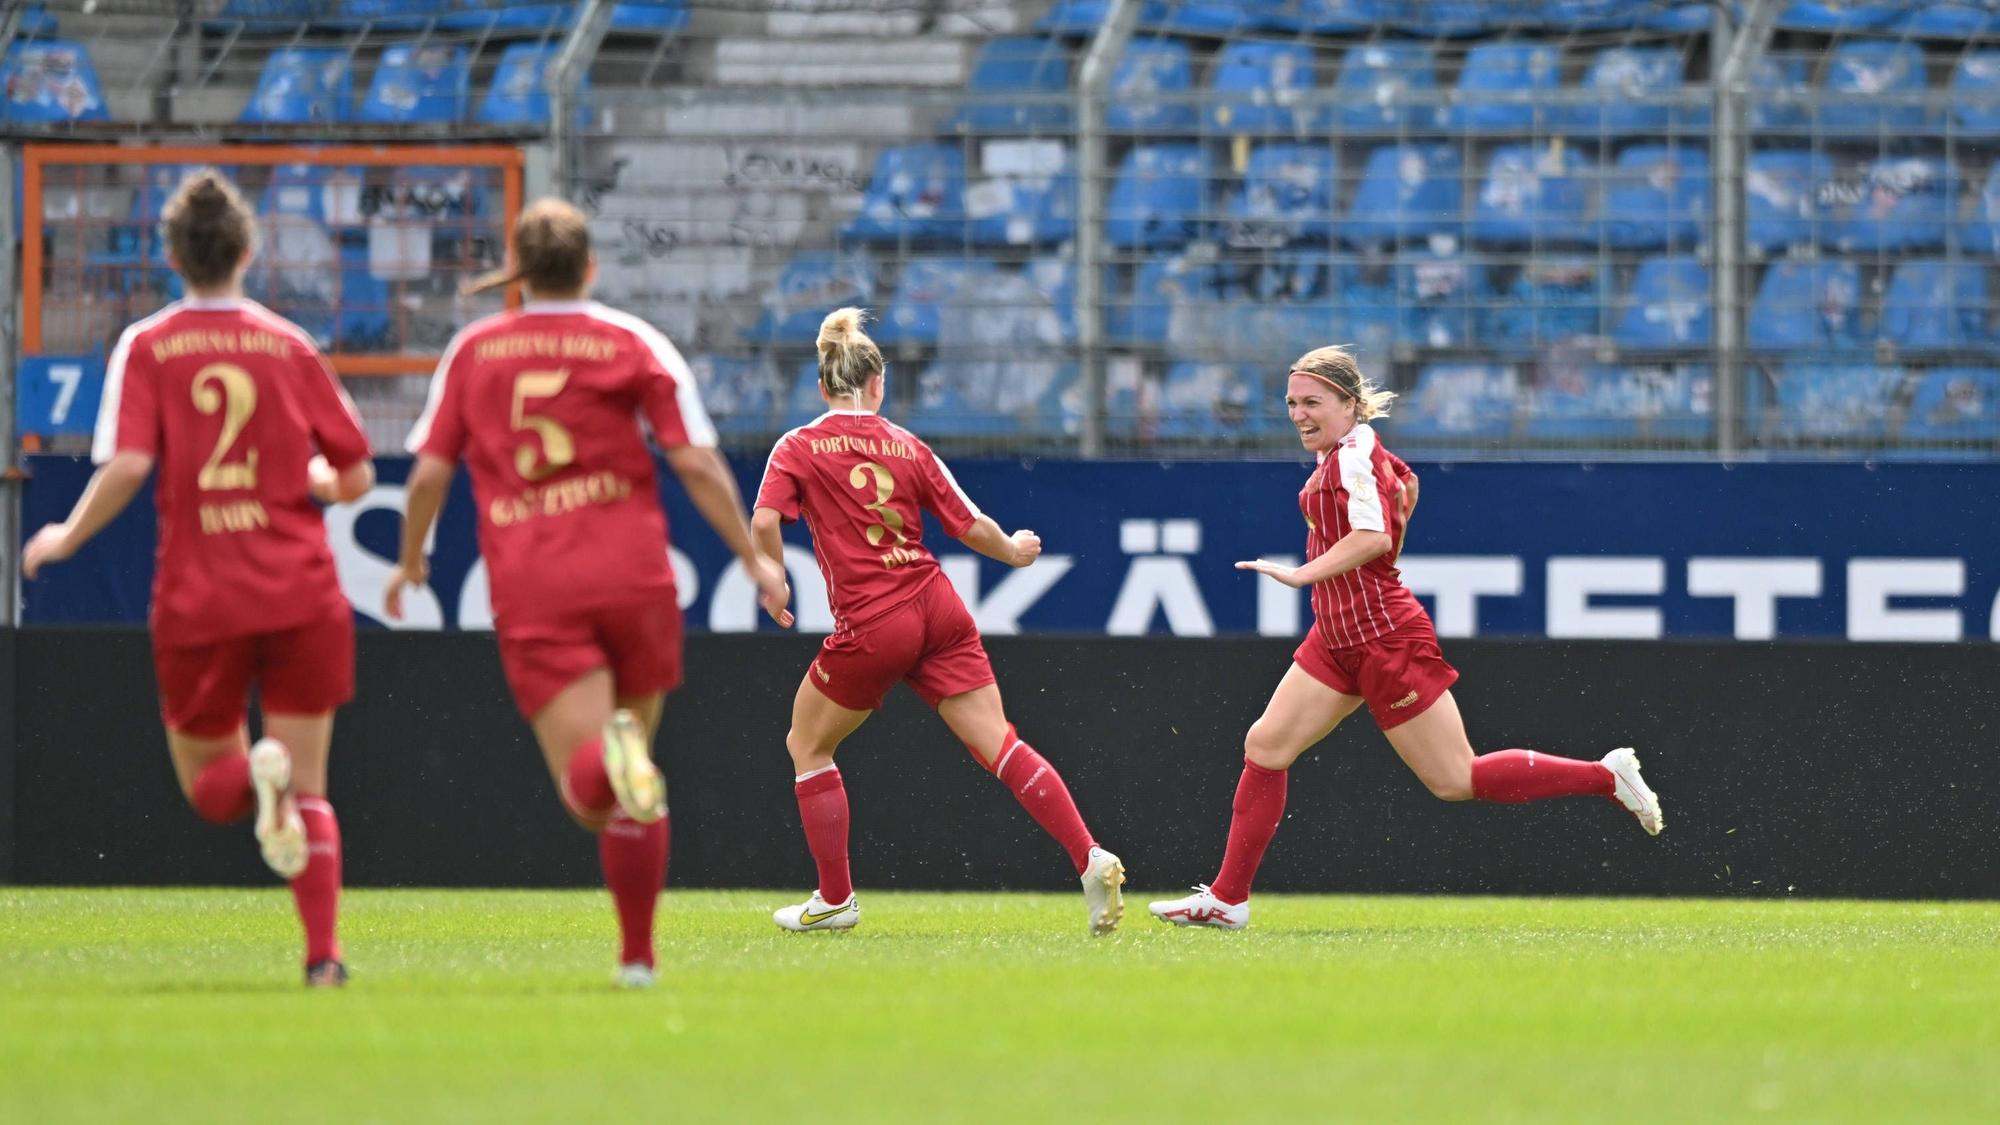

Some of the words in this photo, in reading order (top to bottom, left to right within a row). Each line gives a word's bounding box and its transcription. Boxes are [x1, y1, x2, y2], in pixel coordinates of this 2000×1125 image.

[48, 364, 83, 425] 7
[190, 362, 259, 491] 2
[510, 366, 576, 481] 5
[810, 434, 878, 456] FORTUNA
[849, 462, 907, 547] 3
